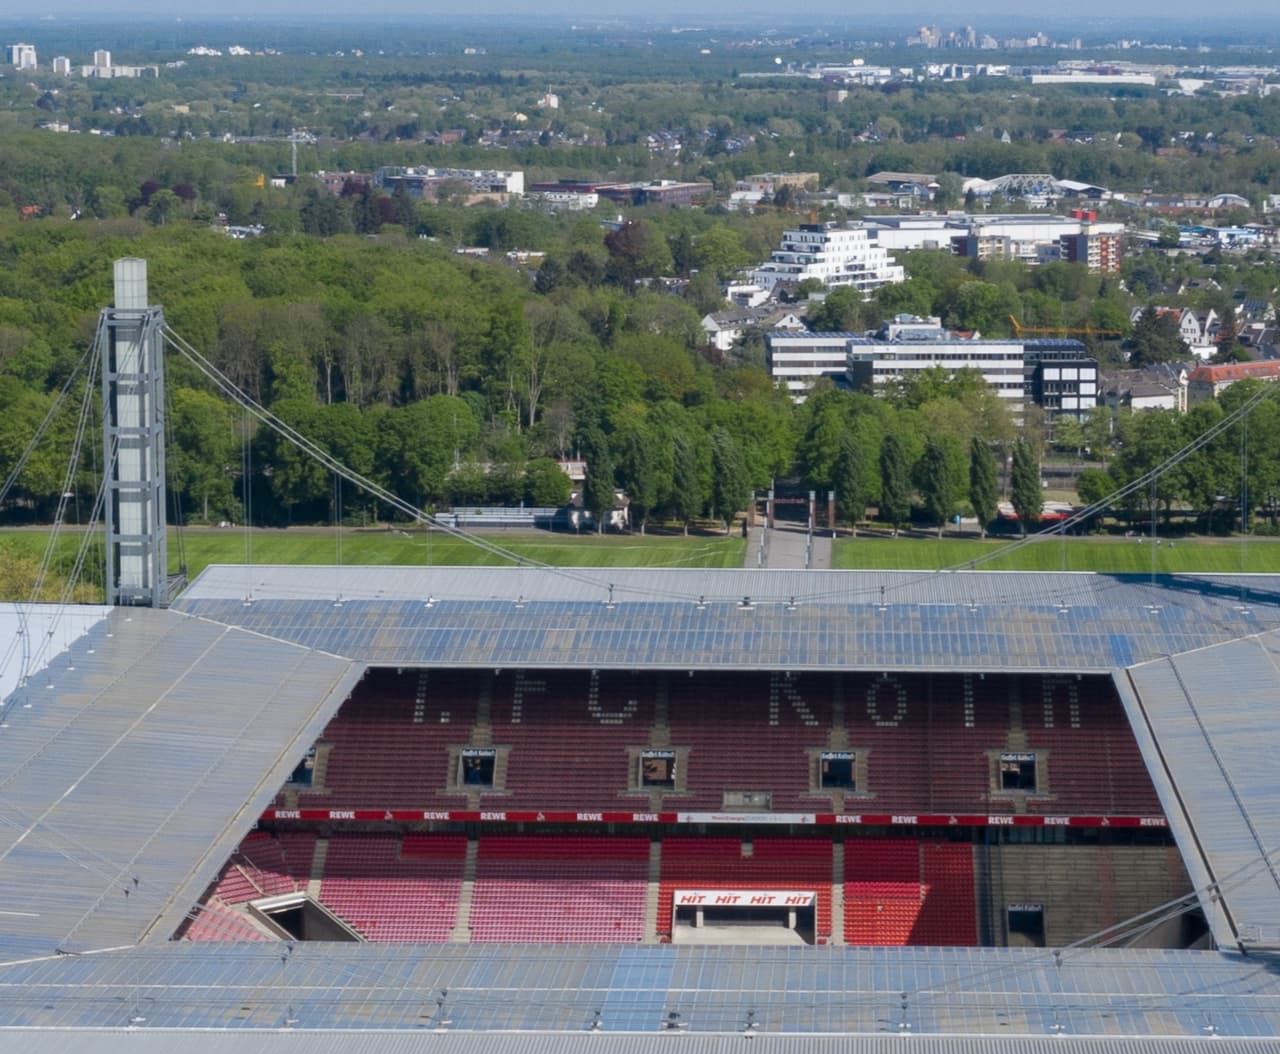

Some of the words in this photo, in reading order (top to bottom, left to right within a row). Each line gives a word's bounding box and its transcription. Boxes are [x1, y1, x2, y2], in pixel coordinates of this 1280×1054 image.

[275, 811, 301, 819] REWE
[329, 811, 355, 820] REWE
[424, 812, 449, 820] REWE
[480, 812, 506, 821] REWE
[577, 813, 602, 821] REWE
[633, 813, 658, 822] REWE
[835, 815, 862, 824] REWE
[891, 816, 918, 824] REWE
[988, 816, 1014, 825] REWE
[1044, 816, 1070, 825] REWE
[1140, 817, 1166, 826] REWE
